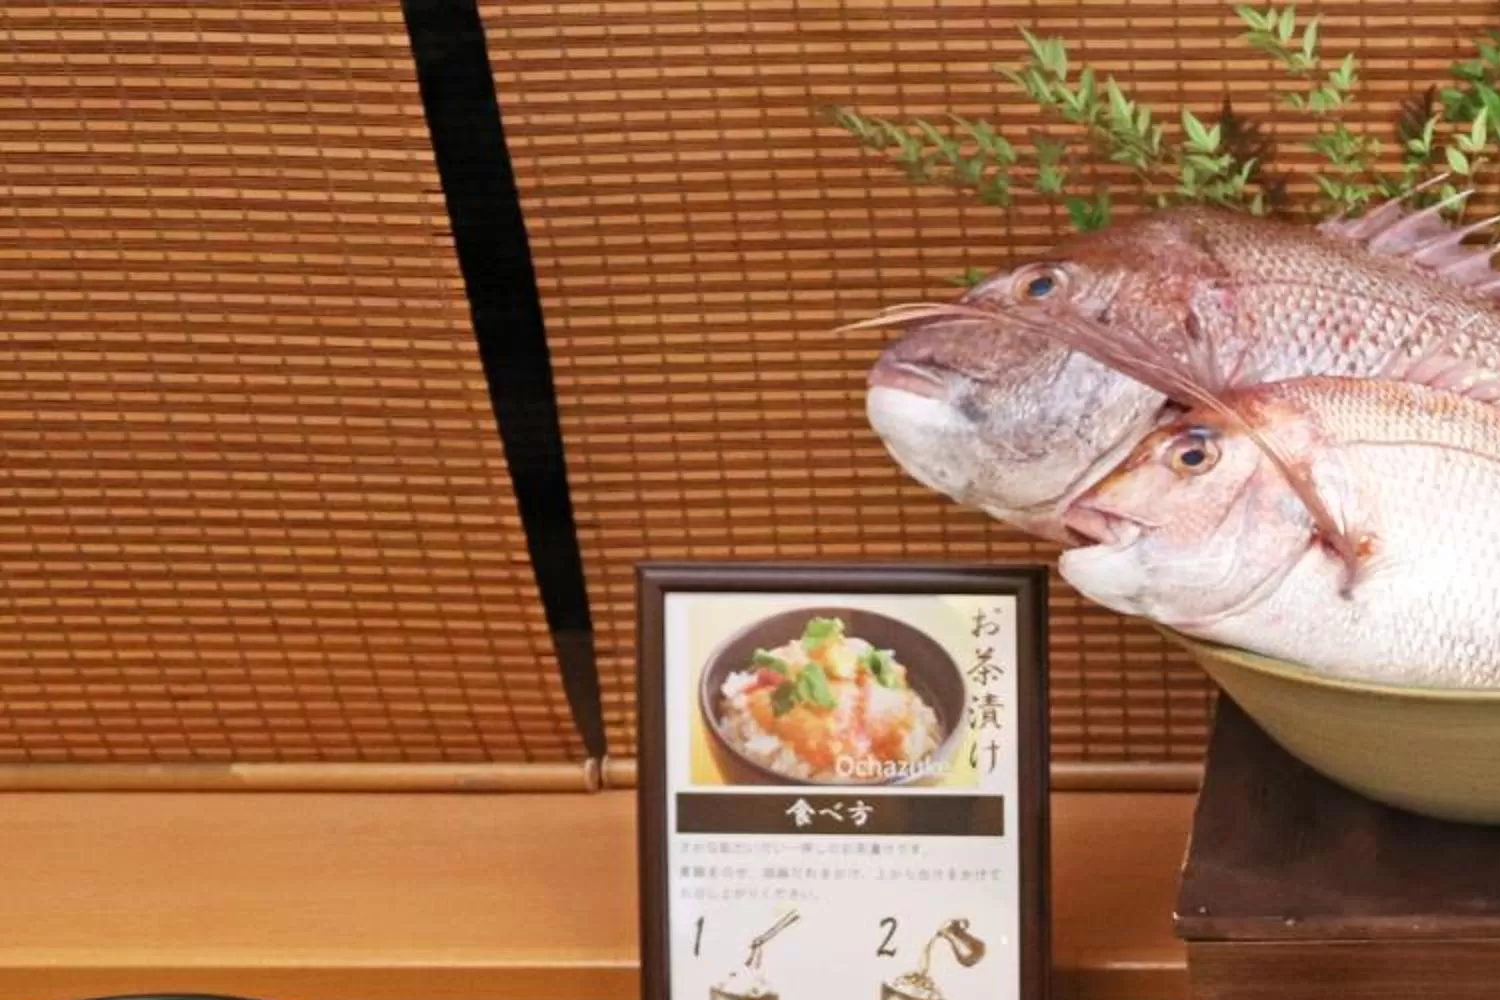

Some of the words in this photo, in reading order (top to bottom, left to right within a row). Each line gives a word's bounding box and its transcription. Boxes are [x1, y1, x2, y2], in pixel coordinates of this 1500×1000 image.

[967, 607, 1005, 773] お茶漬け
[835, 755, 951, 777] Ochazuke
[785, 798, 874, 827] 食べ方
[694, 916, 704, 956] 1
[876, 916, 898, 957] 2
